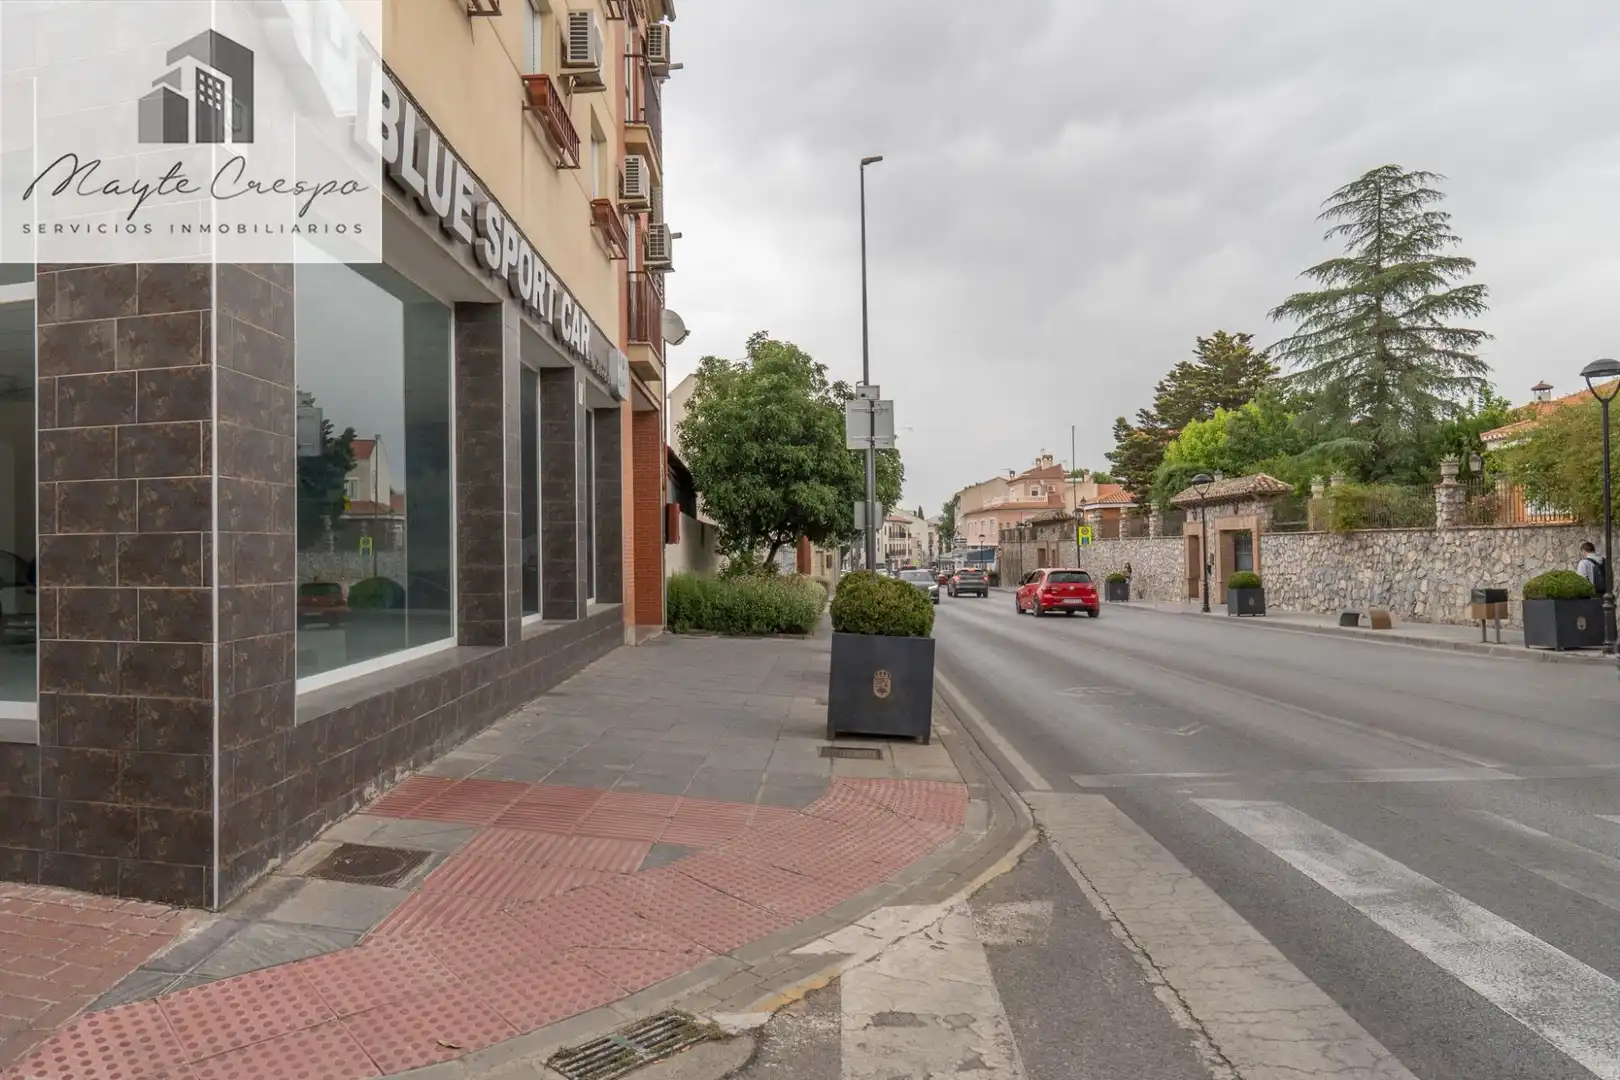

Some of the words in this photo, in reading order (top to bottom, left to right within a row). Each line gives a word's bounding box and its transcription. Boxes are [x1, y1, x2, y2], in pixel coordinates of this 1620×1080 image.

[365, 58, 477, 245] BLUE
[478, 200, 559, 325] SPORT
[560, 293, 591, 359] CAR
